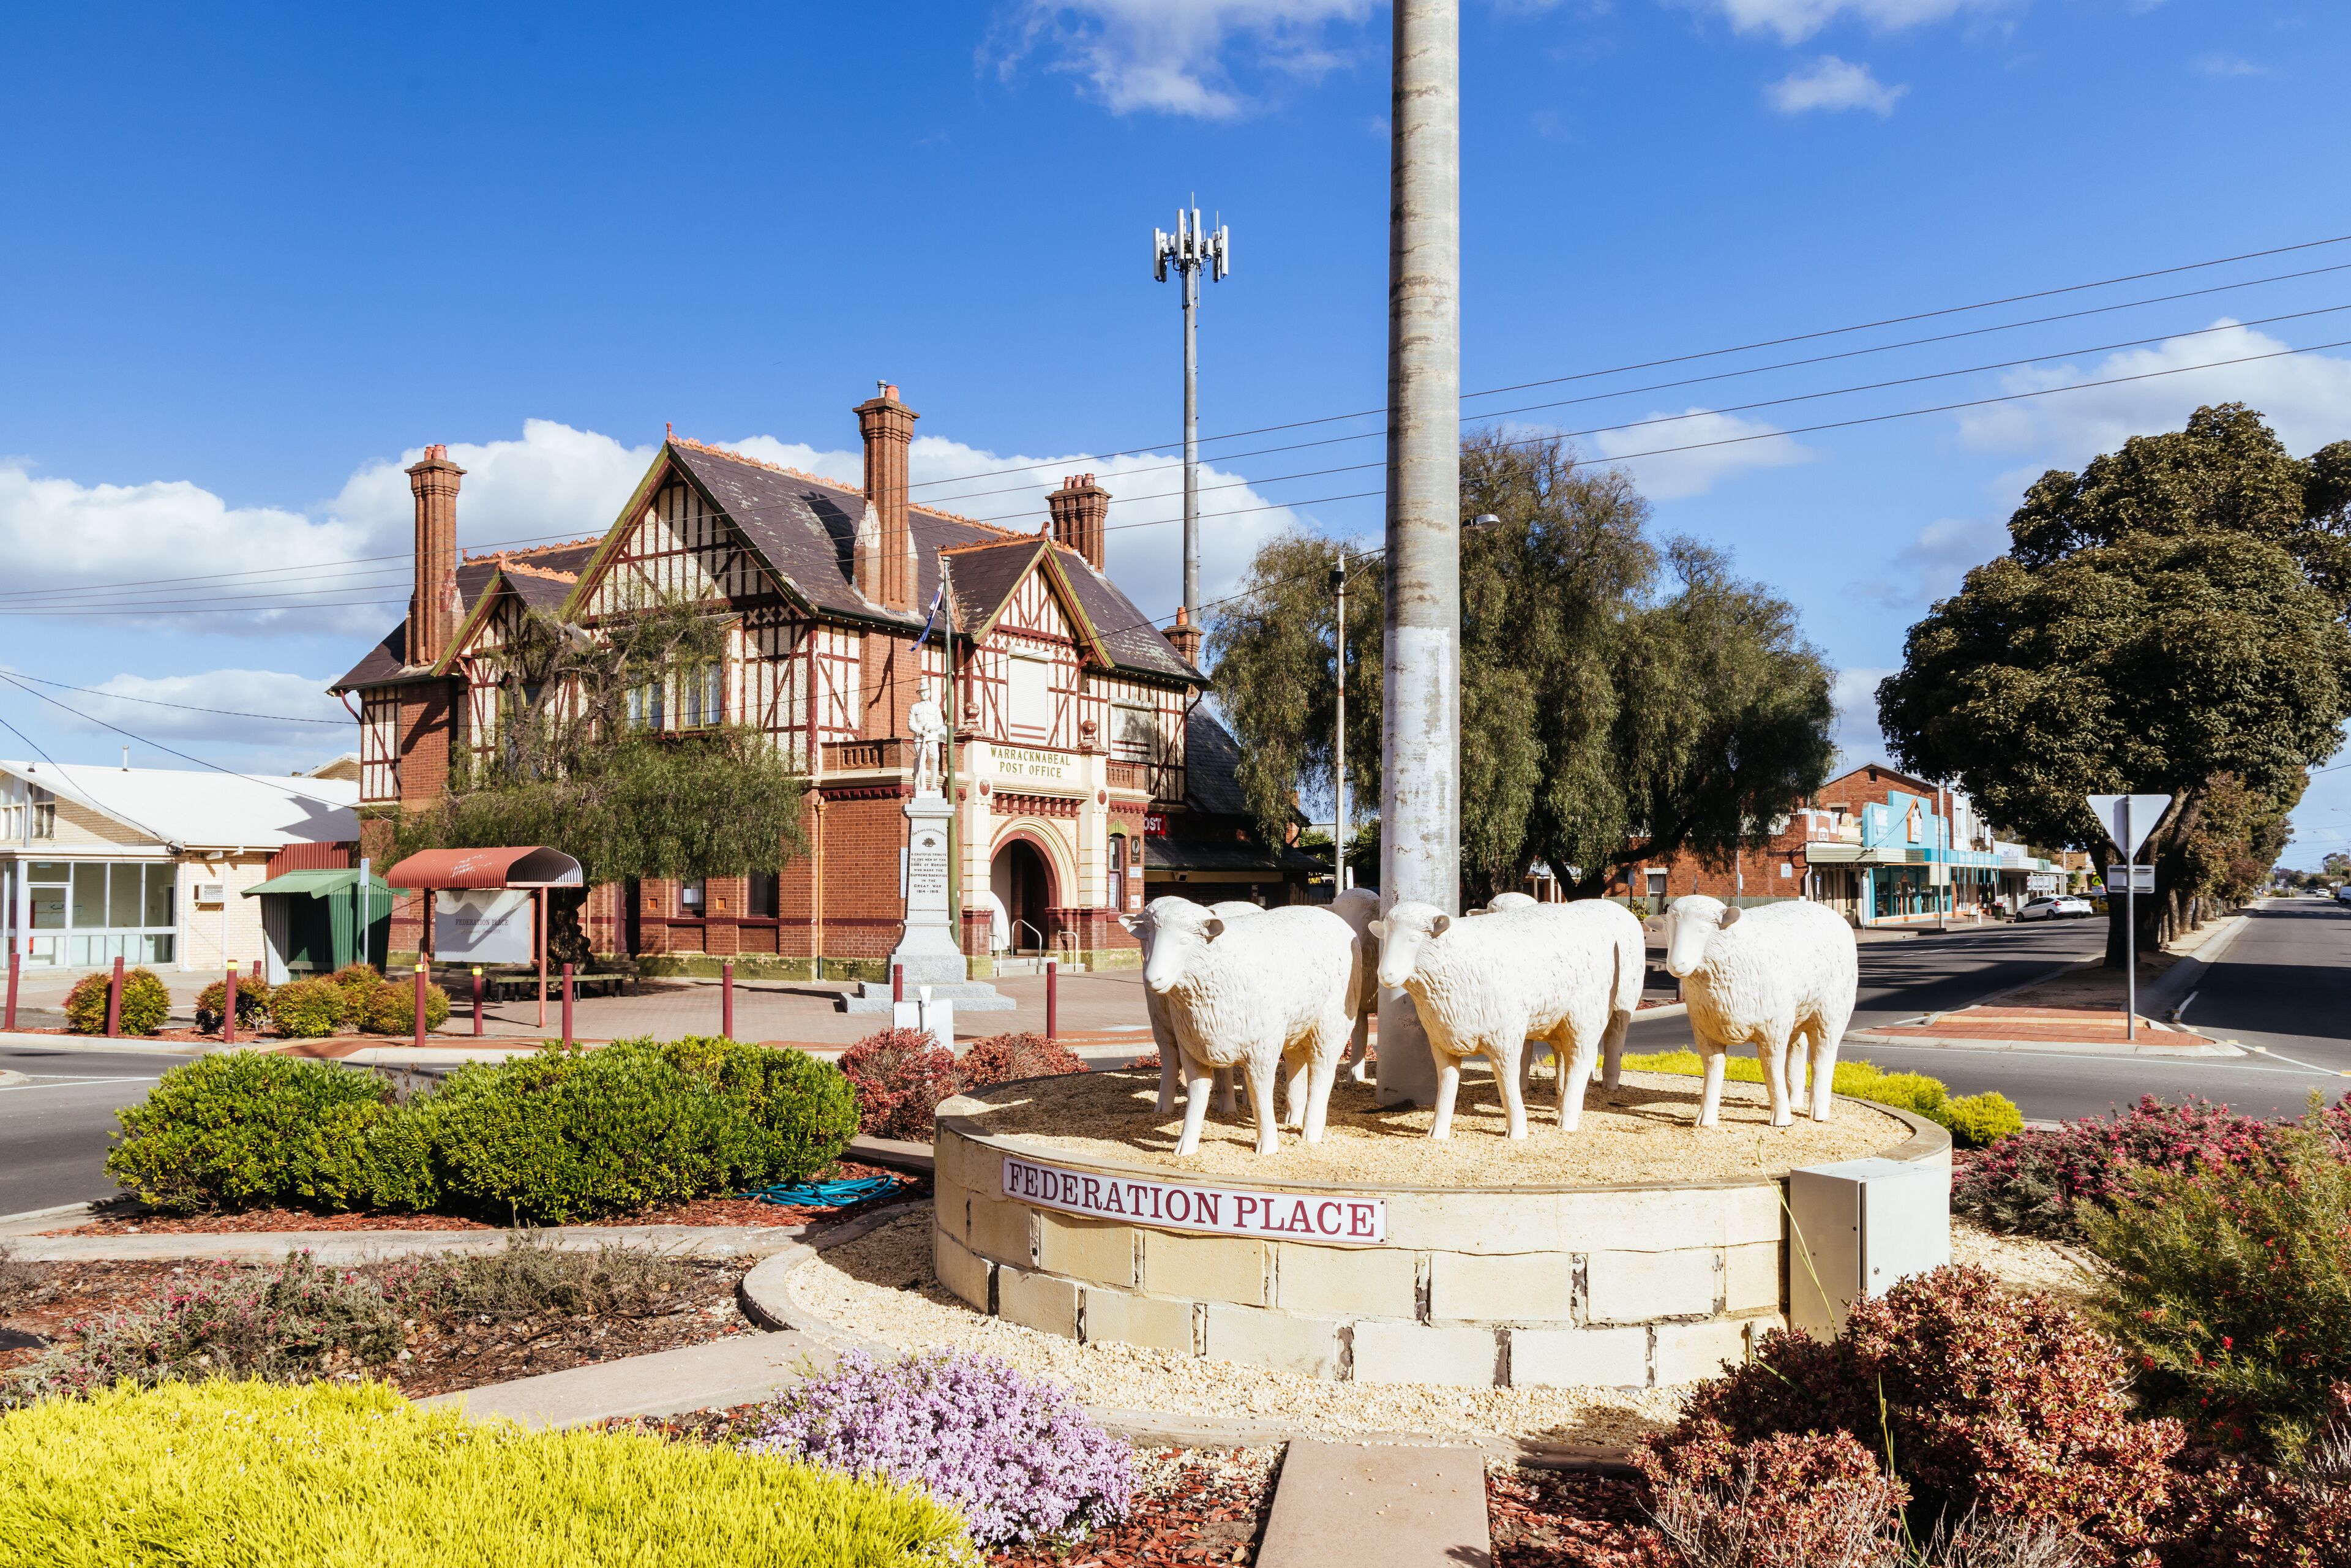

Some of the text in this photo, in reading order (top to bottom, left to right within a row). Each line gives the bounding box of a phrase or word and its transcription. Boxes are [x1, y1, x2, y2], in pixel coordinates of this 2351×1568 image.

[991, 747, 1070, 765] WARRACKNABEAL
[1000, 762, 1061, 778] POST OFFICE
[1144, 817, 1161, 831] OST
[1009, 1162, 1374, 1237] FEDERATION PLACE
